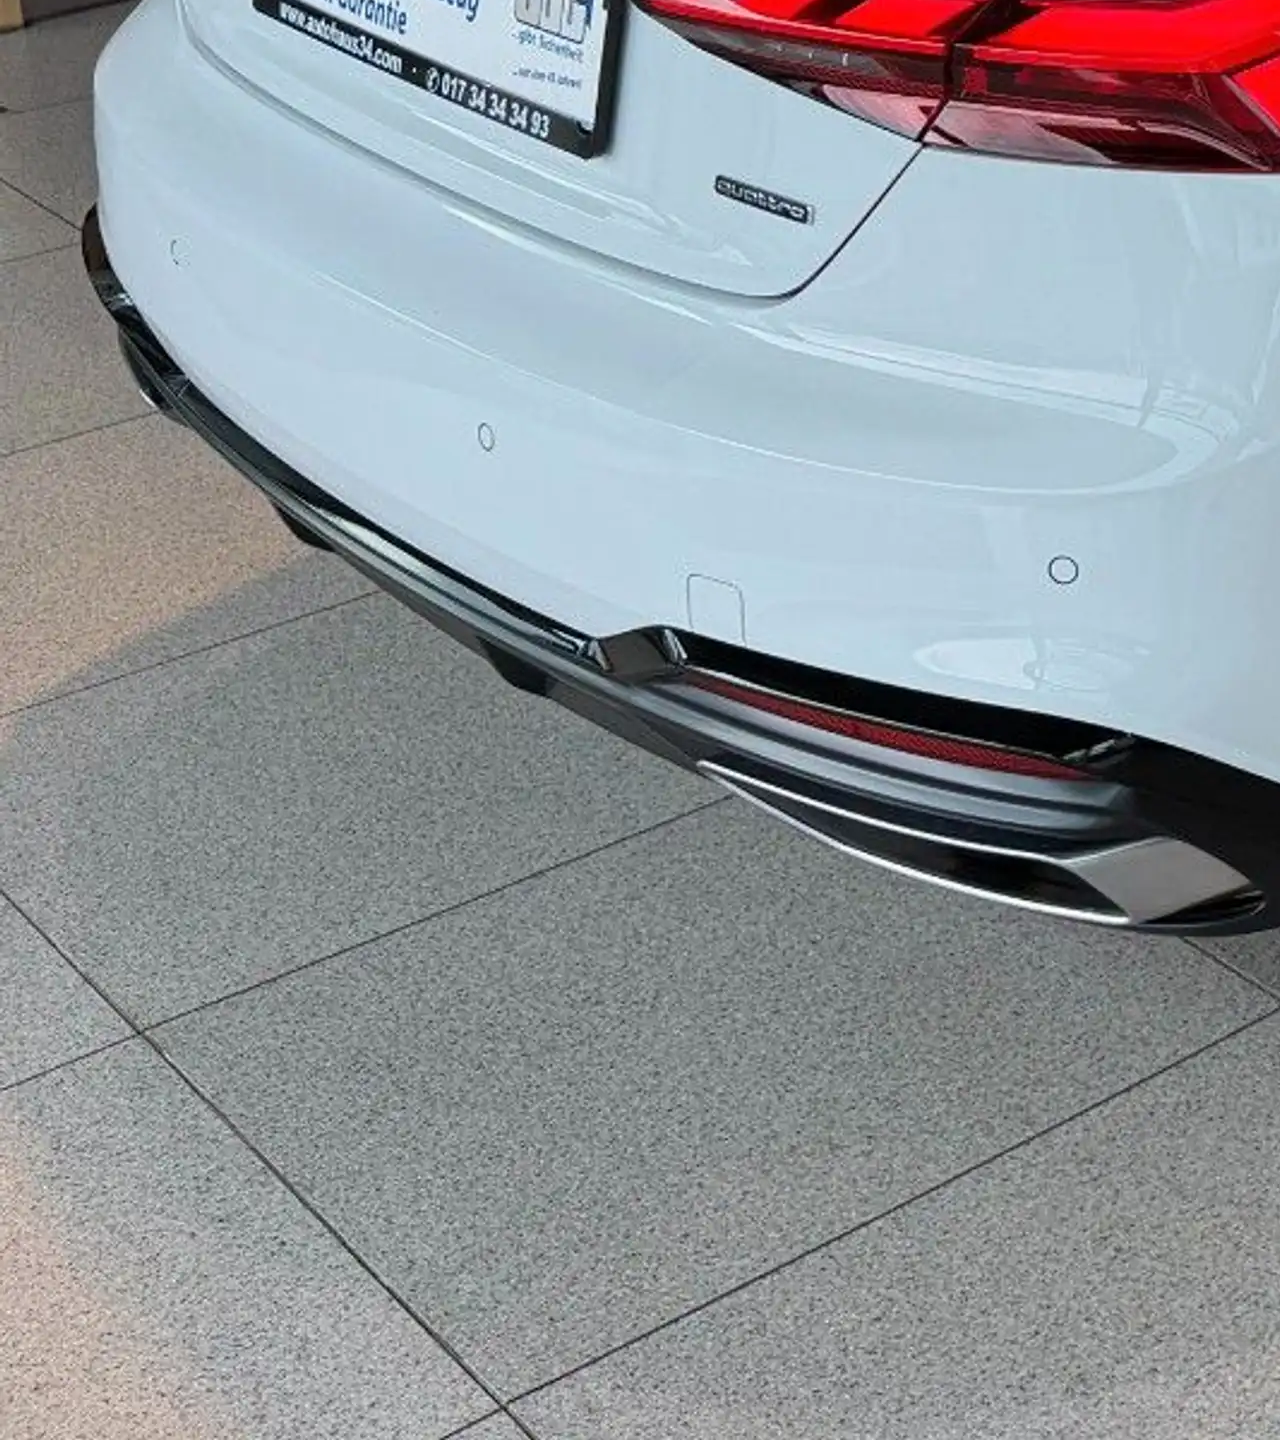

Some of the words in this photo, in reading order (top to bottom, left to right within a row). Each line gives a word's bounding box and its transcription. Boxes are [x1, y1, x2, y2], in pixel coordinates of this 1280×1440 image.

[279, 0, 403, 74] www.autohaus34.com
[441, 71, 467, 103] 017
[467, 83, 487, 112] 34
[487, 92, 508, 122] 34
[508, 101, 530, 130] 34
[529, 110, 550, 139] 93
[717, 178, 806, 219] quattro
